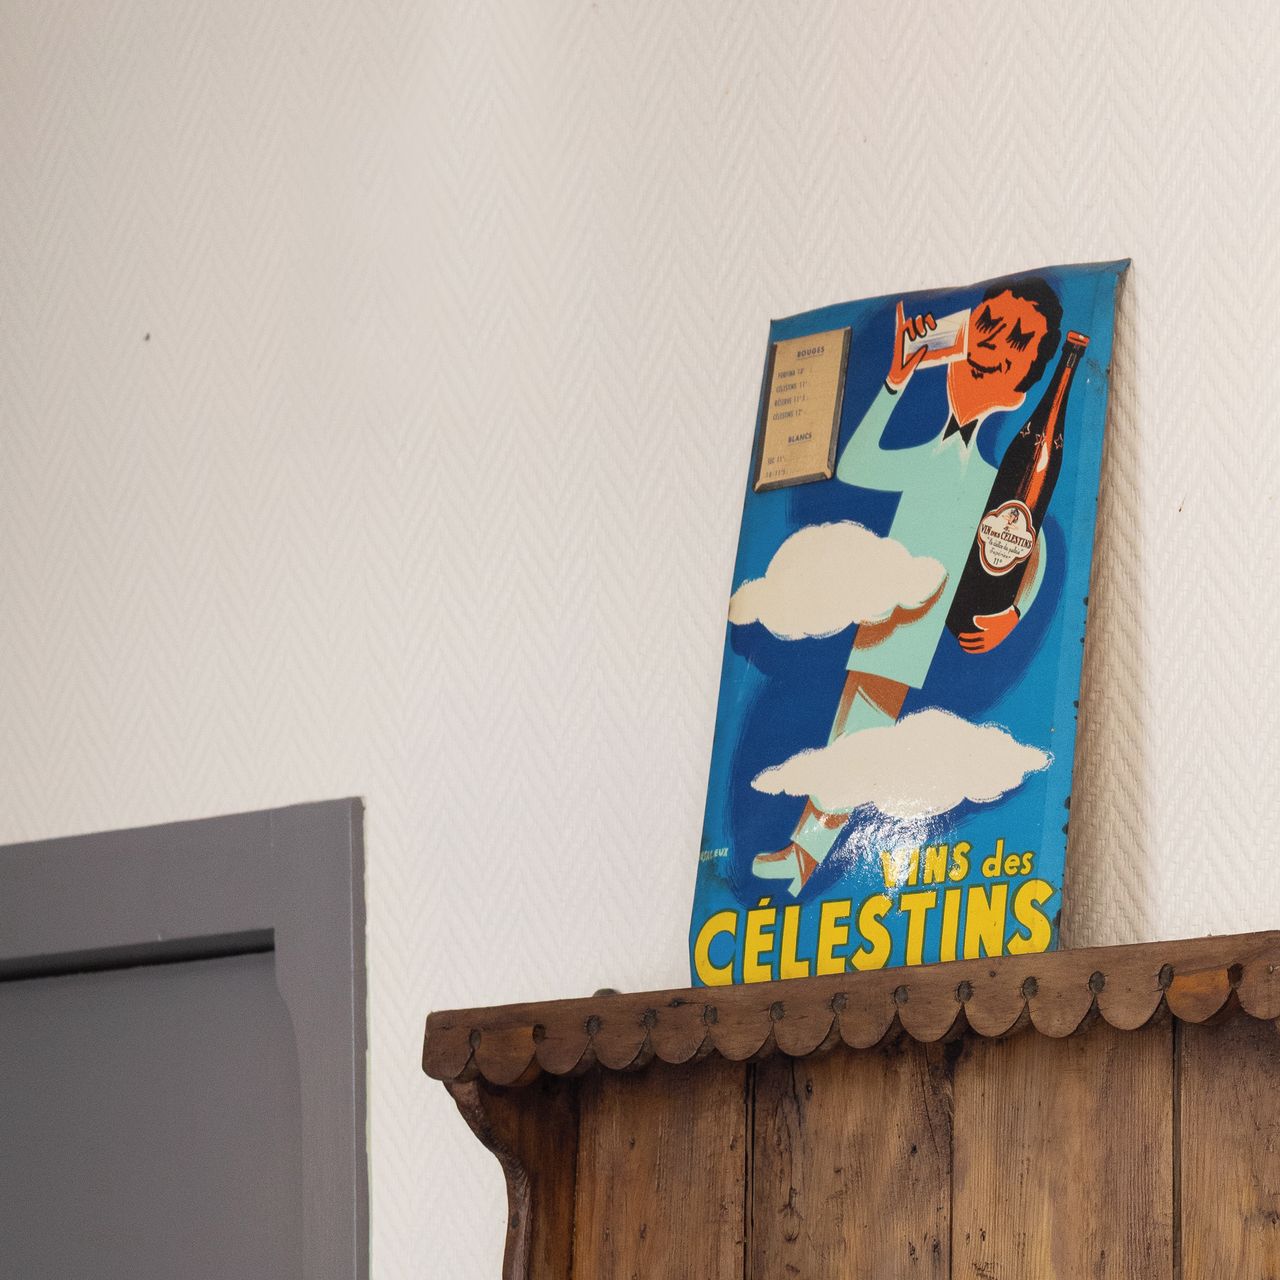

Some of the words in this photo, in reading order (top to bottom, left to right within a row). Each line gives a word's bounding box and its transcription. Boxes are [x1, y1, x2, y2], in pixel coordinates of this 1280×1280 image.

[881, 842, 971, 887] VINS
[981, 839, 1034, 878] des
[694, 878, 1055, 987] CÉLESTINS
